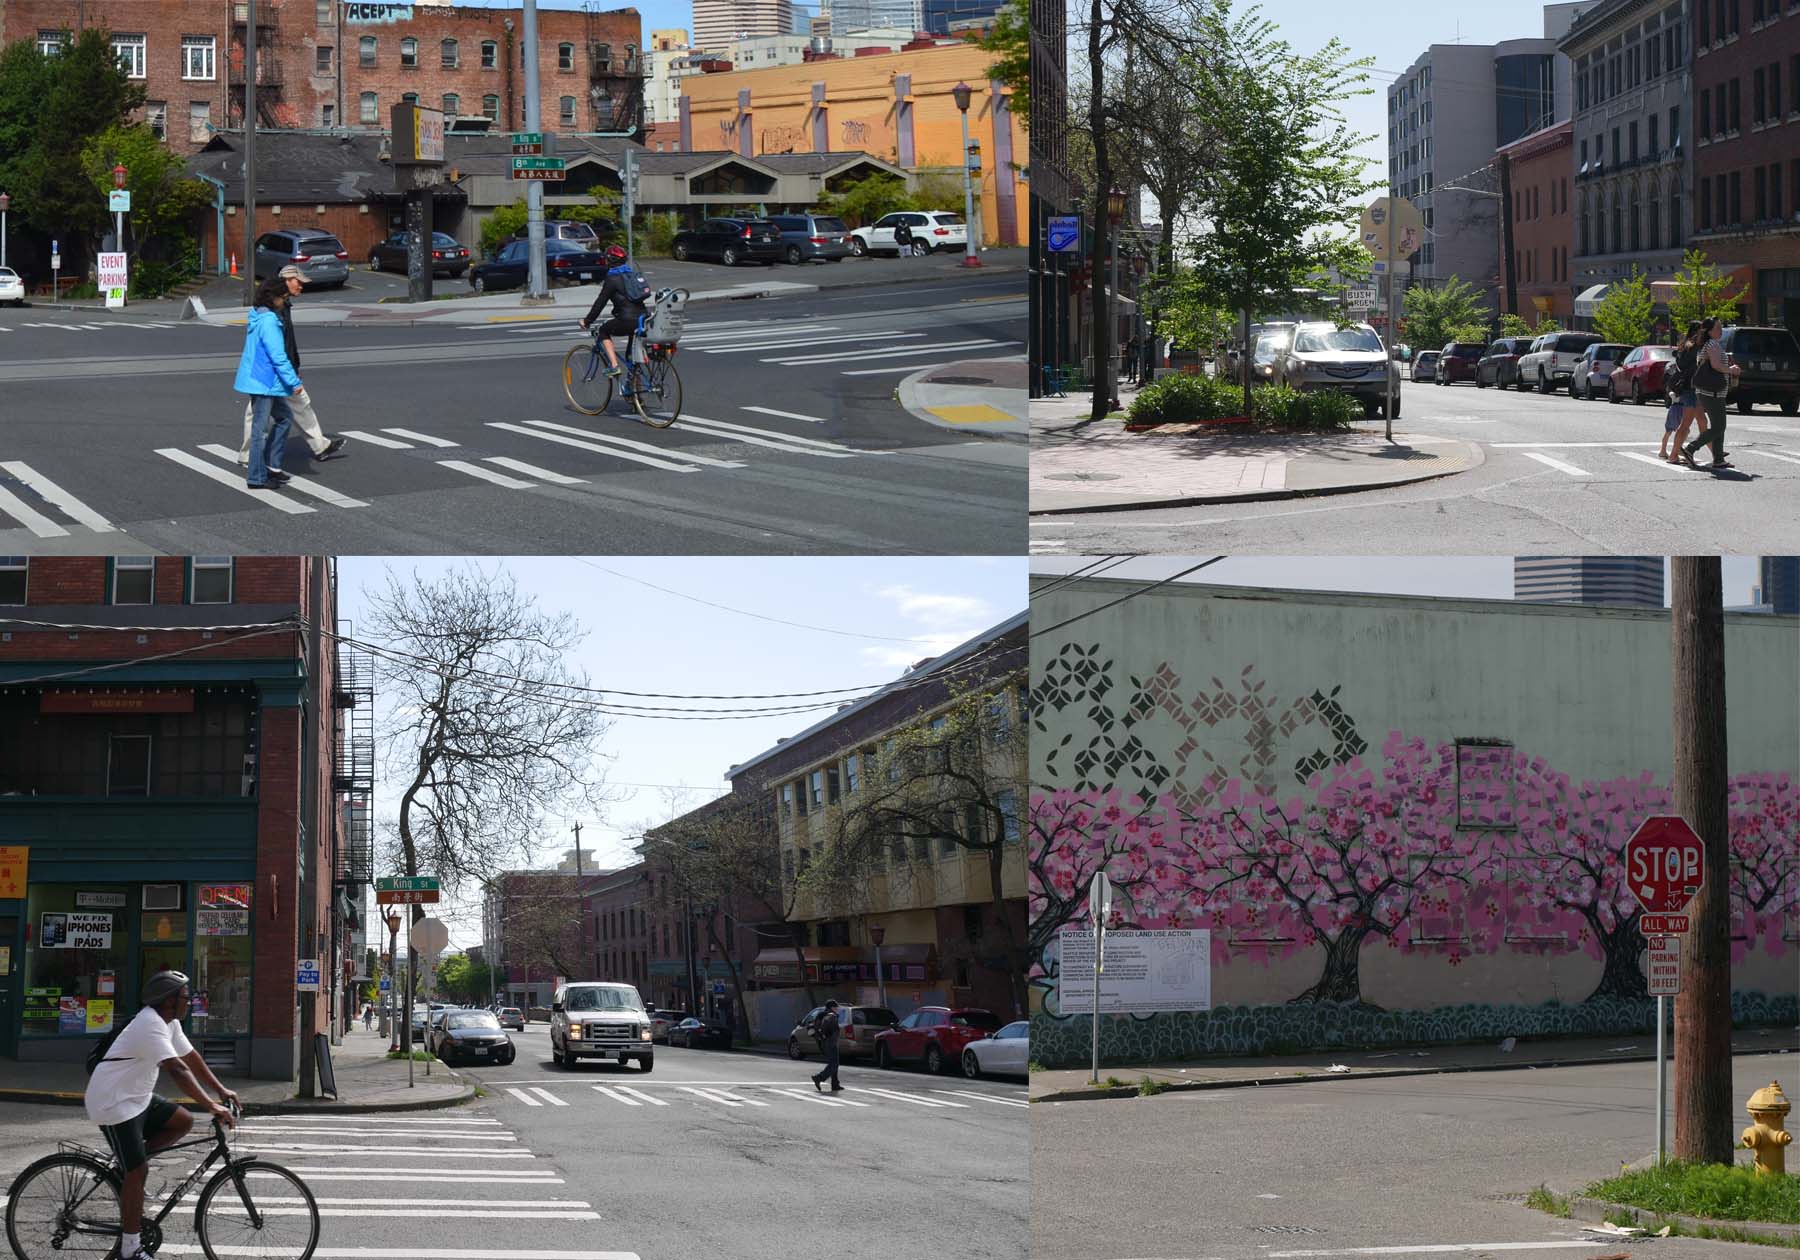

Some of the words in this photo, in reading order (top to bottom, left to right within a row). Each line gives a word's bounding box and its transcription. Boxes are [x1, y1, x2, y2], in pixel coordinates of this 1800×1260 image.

[515, 160, 528, 168] 8th
[101, 255, 125, 269] EVENT
[98, 272, 127, 287] PARKING
[1348, 291, 1371, 299] BUSH
[1632, 847, 1699, 882] STOP
[393, 879, 413, 889] King
[200, 887, 248, 905] OPEN
[67, 922, 111, 933] IPHONES
[1645, 919, 1661, 930] ALL
[1668, 919, 1686, 930] WAY
[74, 937, 103, 948] IPADS
[1650, 938, 1665, 949] NO
[1651, 953, 1678, 962] PARKING
[1653, 965, 1677, 975] WITHIN
[1661, 978, 1677, 988] FEET
